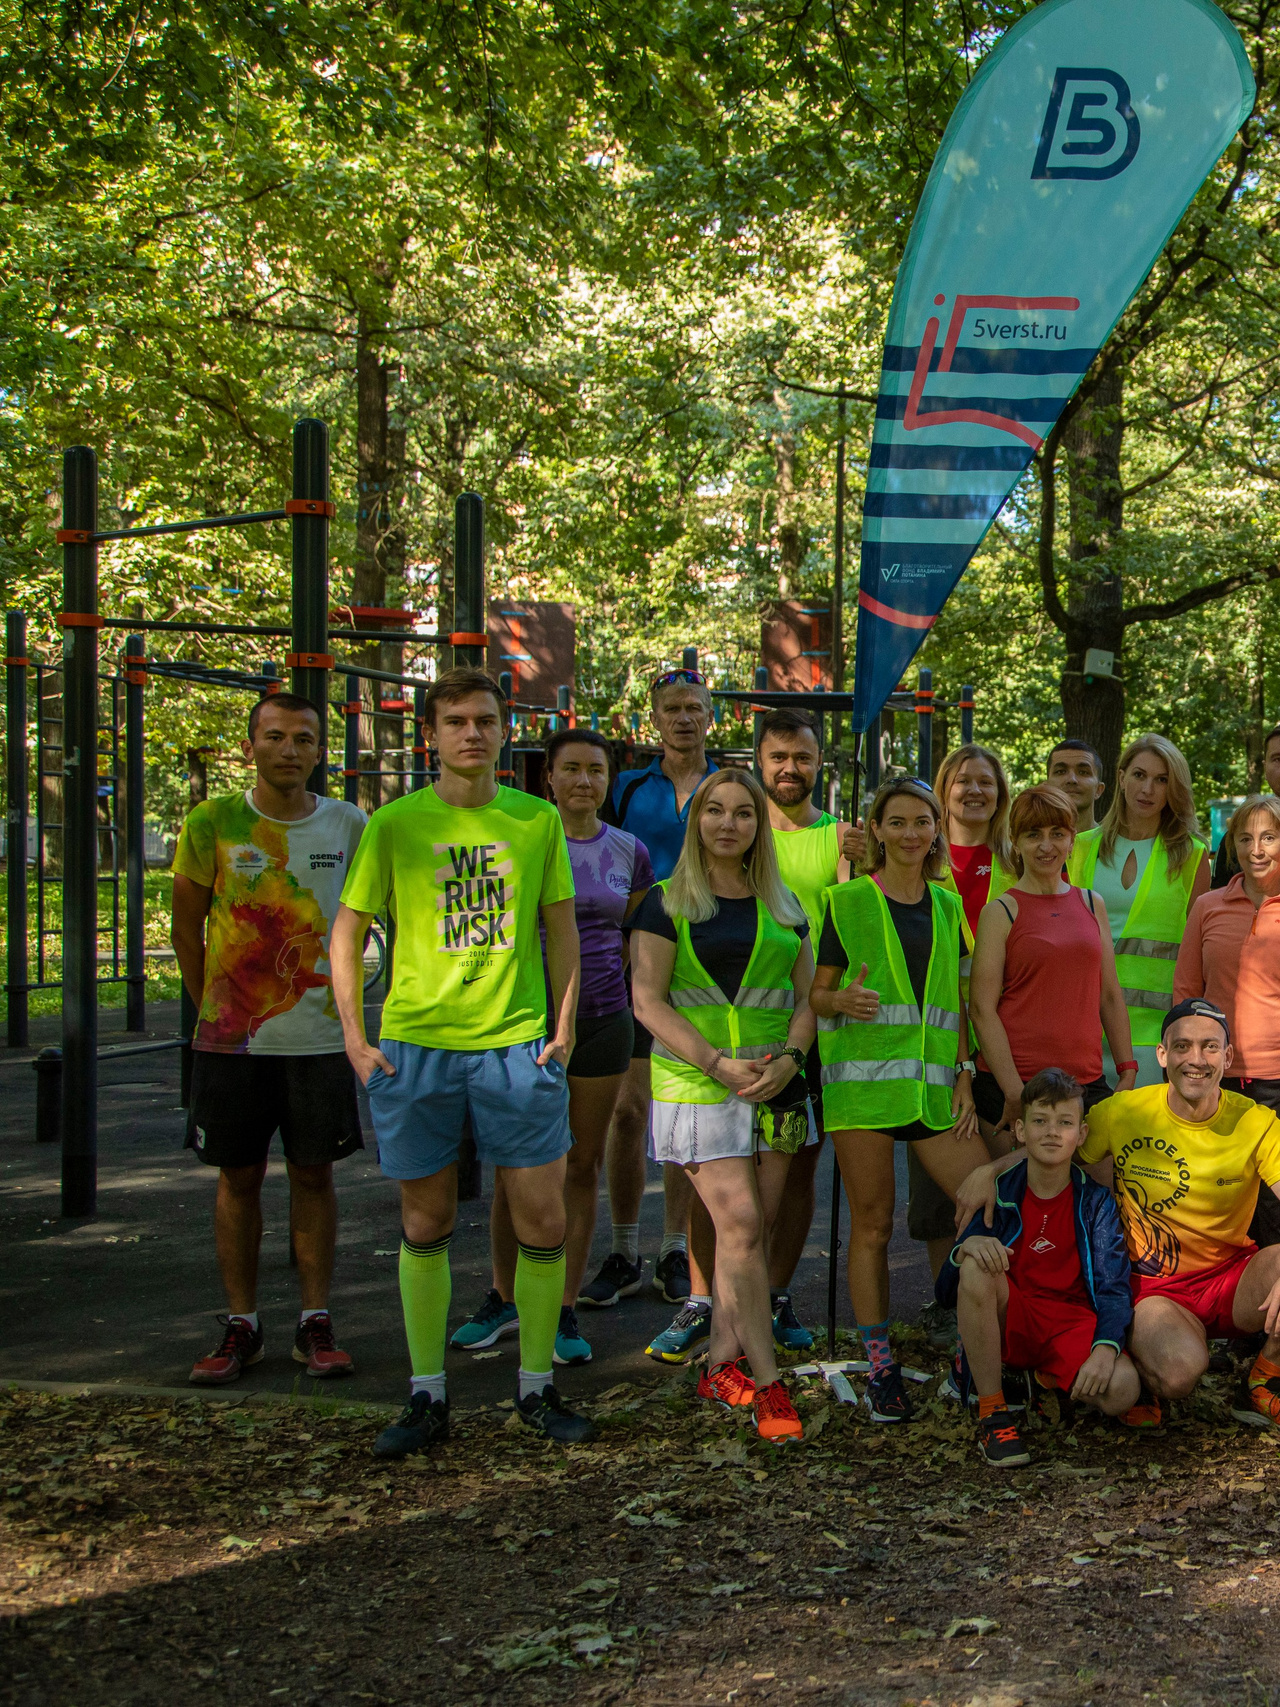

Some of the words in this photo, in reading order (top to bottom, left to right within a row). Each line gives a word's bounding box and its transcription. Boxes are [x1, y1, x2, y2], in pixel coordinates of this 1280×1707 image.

[973, 318, 1068, 341] 5verst.ru
[310, 861, 336, 870] grom
[448, 845, 499, 879] WE
[444, 878, 505, 913] RUN
[444, 912, 508, 949] MSK
[458, 960, 473, 968] JUST
[1129, 1169, 1172, 1183] ПОЛУМАРАФОН
[1130, 1164, 1171, 1177] ЯРОСЛАВСКИЙ
[1151, 1157, 1190, 1213] КОЛЬЦО
